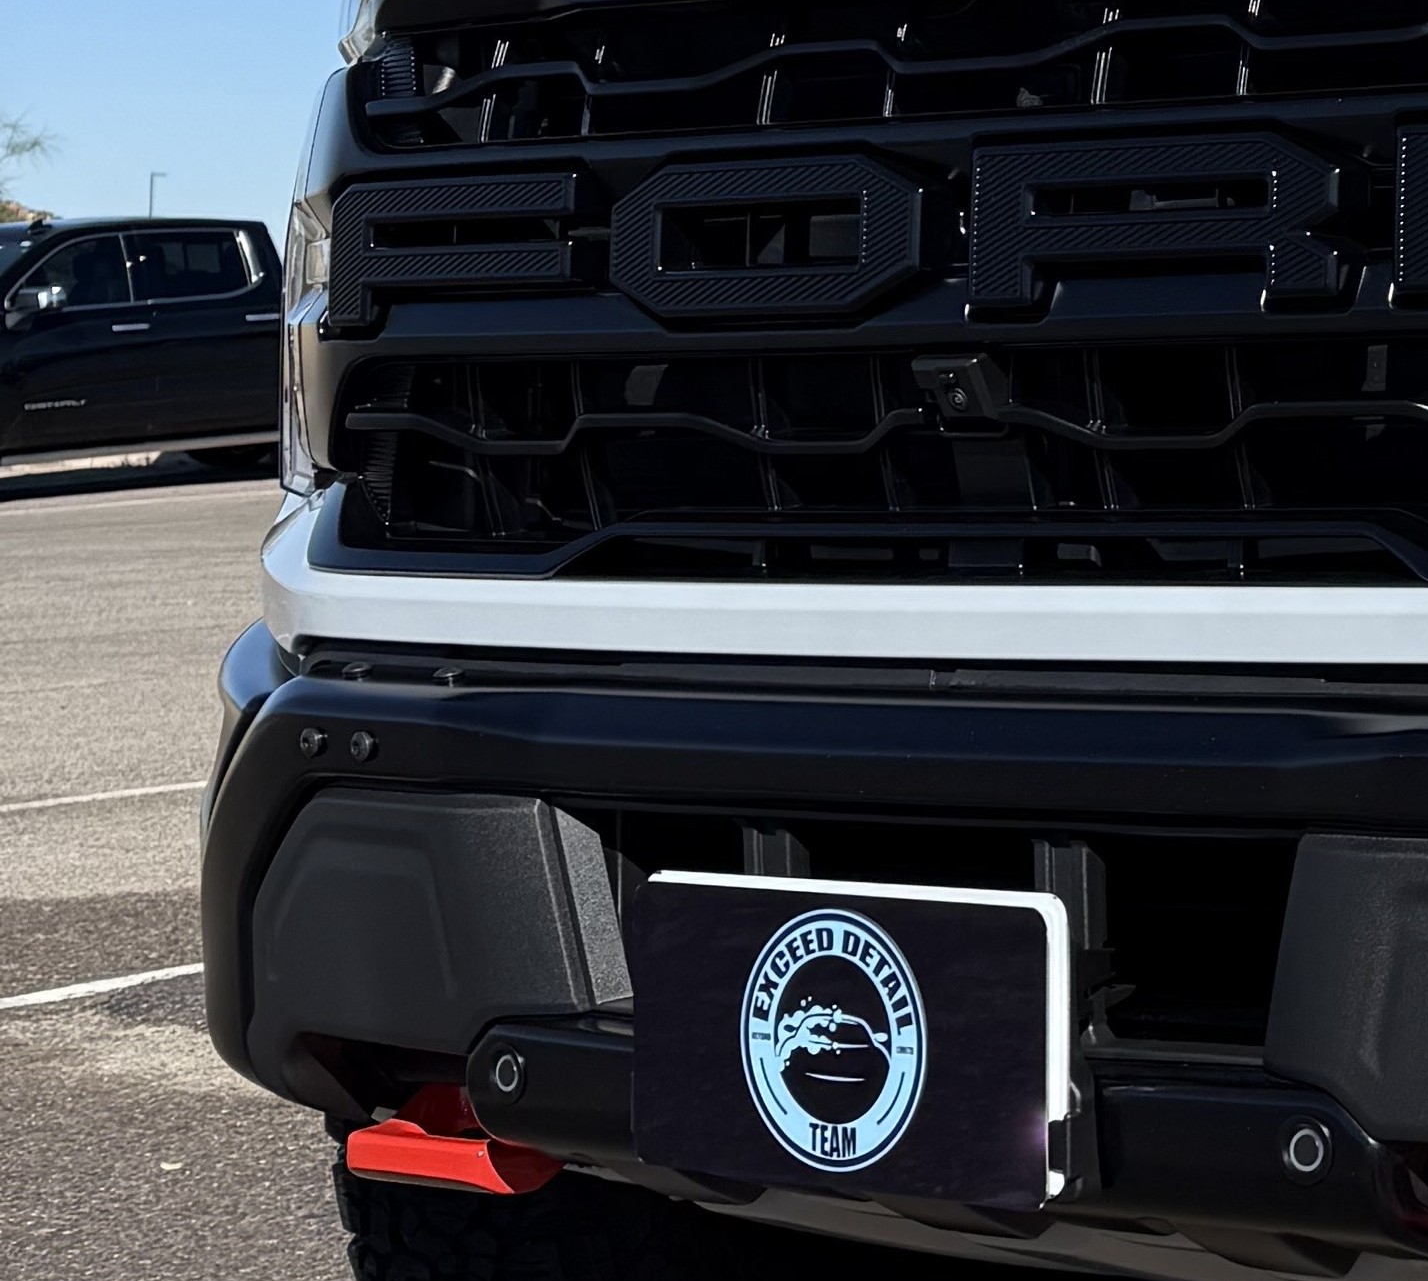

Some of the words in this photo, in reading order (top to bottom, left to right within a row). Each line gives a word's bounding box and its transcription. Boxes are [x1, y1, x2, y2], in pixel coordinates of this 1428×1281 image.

[751, 927, 834, 1022] EXCEED
[841, 929, 913, 1036] DETAIL
[808, 1121, 857, 1159] TEAM
